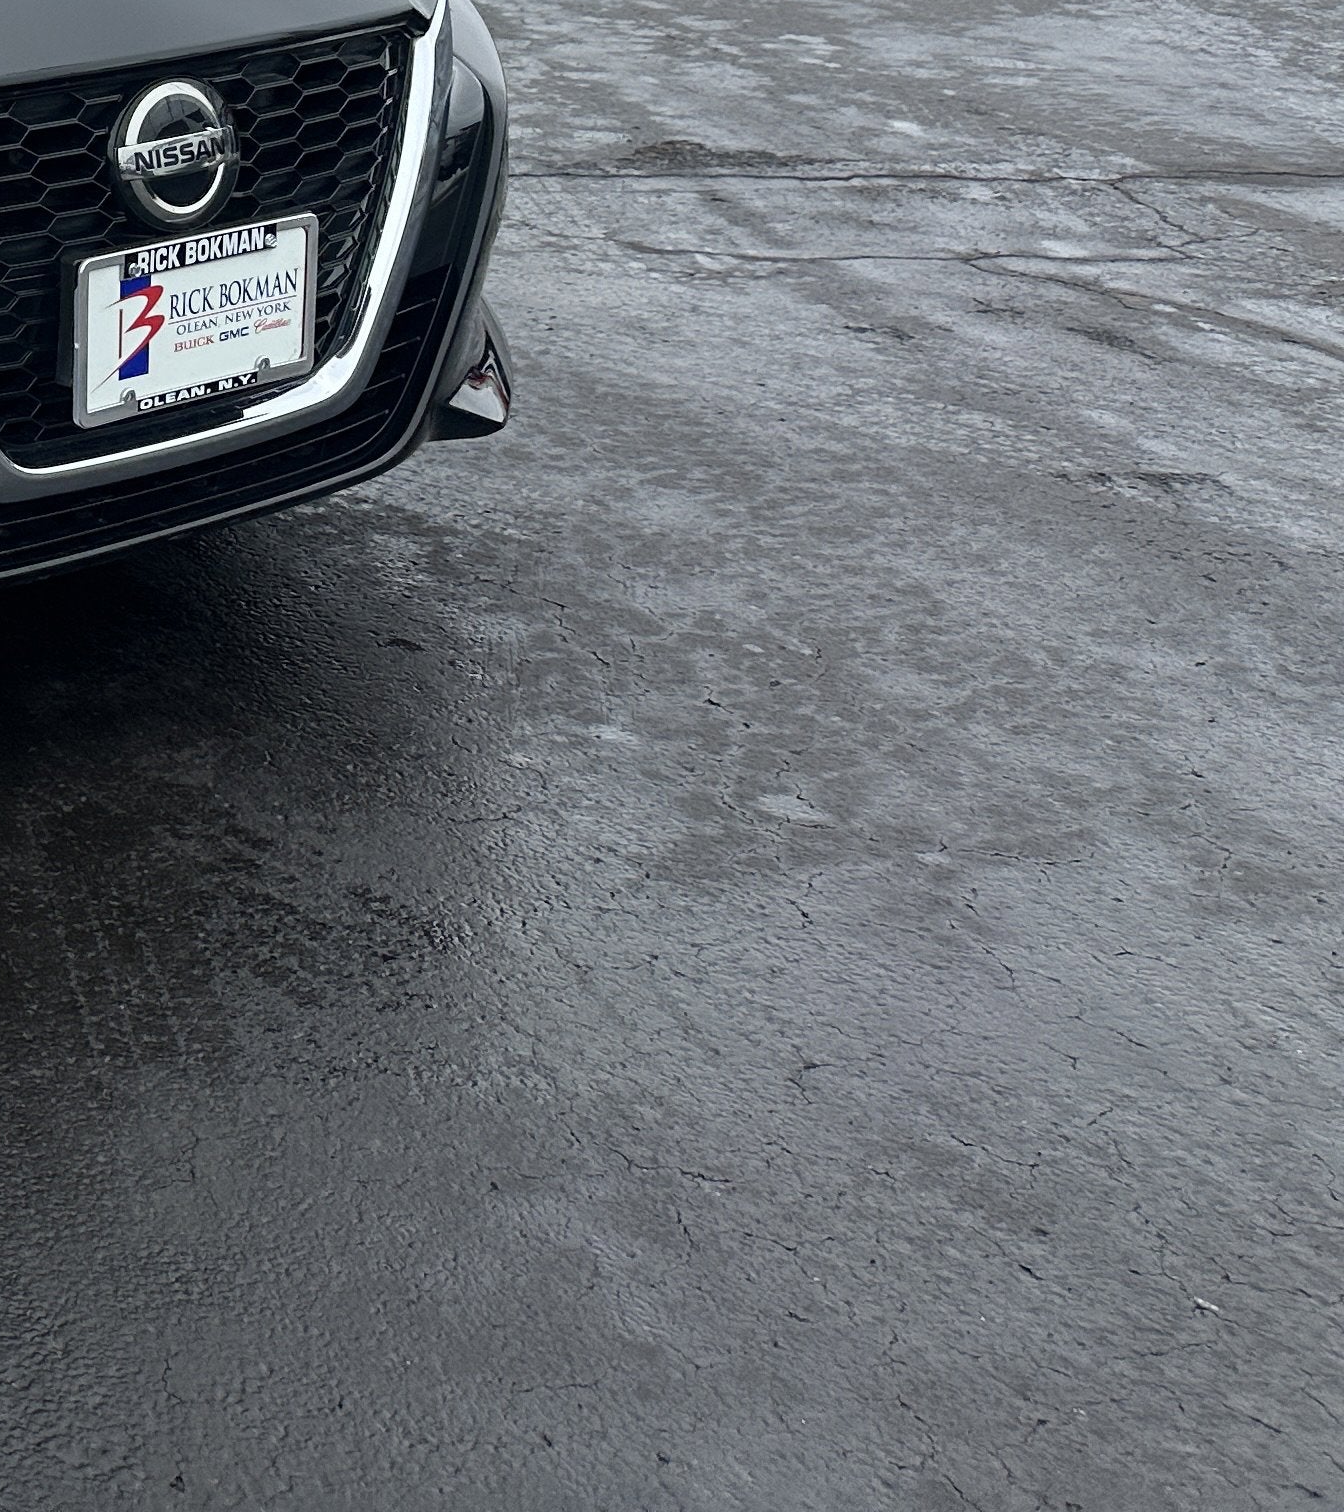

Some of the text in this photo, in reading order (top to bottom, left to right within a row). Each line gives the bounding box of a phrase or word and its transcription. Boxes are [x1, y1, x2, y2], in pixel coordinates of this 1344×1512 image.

[133, 138, 226, 172] NISSAN
[137, 226, 264, 275] RICK BOKMAN
[169, 268, 299, 320] RICK BOKMAN
[224, 308, 254, 326] NEW
[256, 301, 291, 317] YORK
[173, 335, 214, 353] BUICK
[219, 326, 250, 342] GMC
[218, 373, 256, 390] N.Y.
